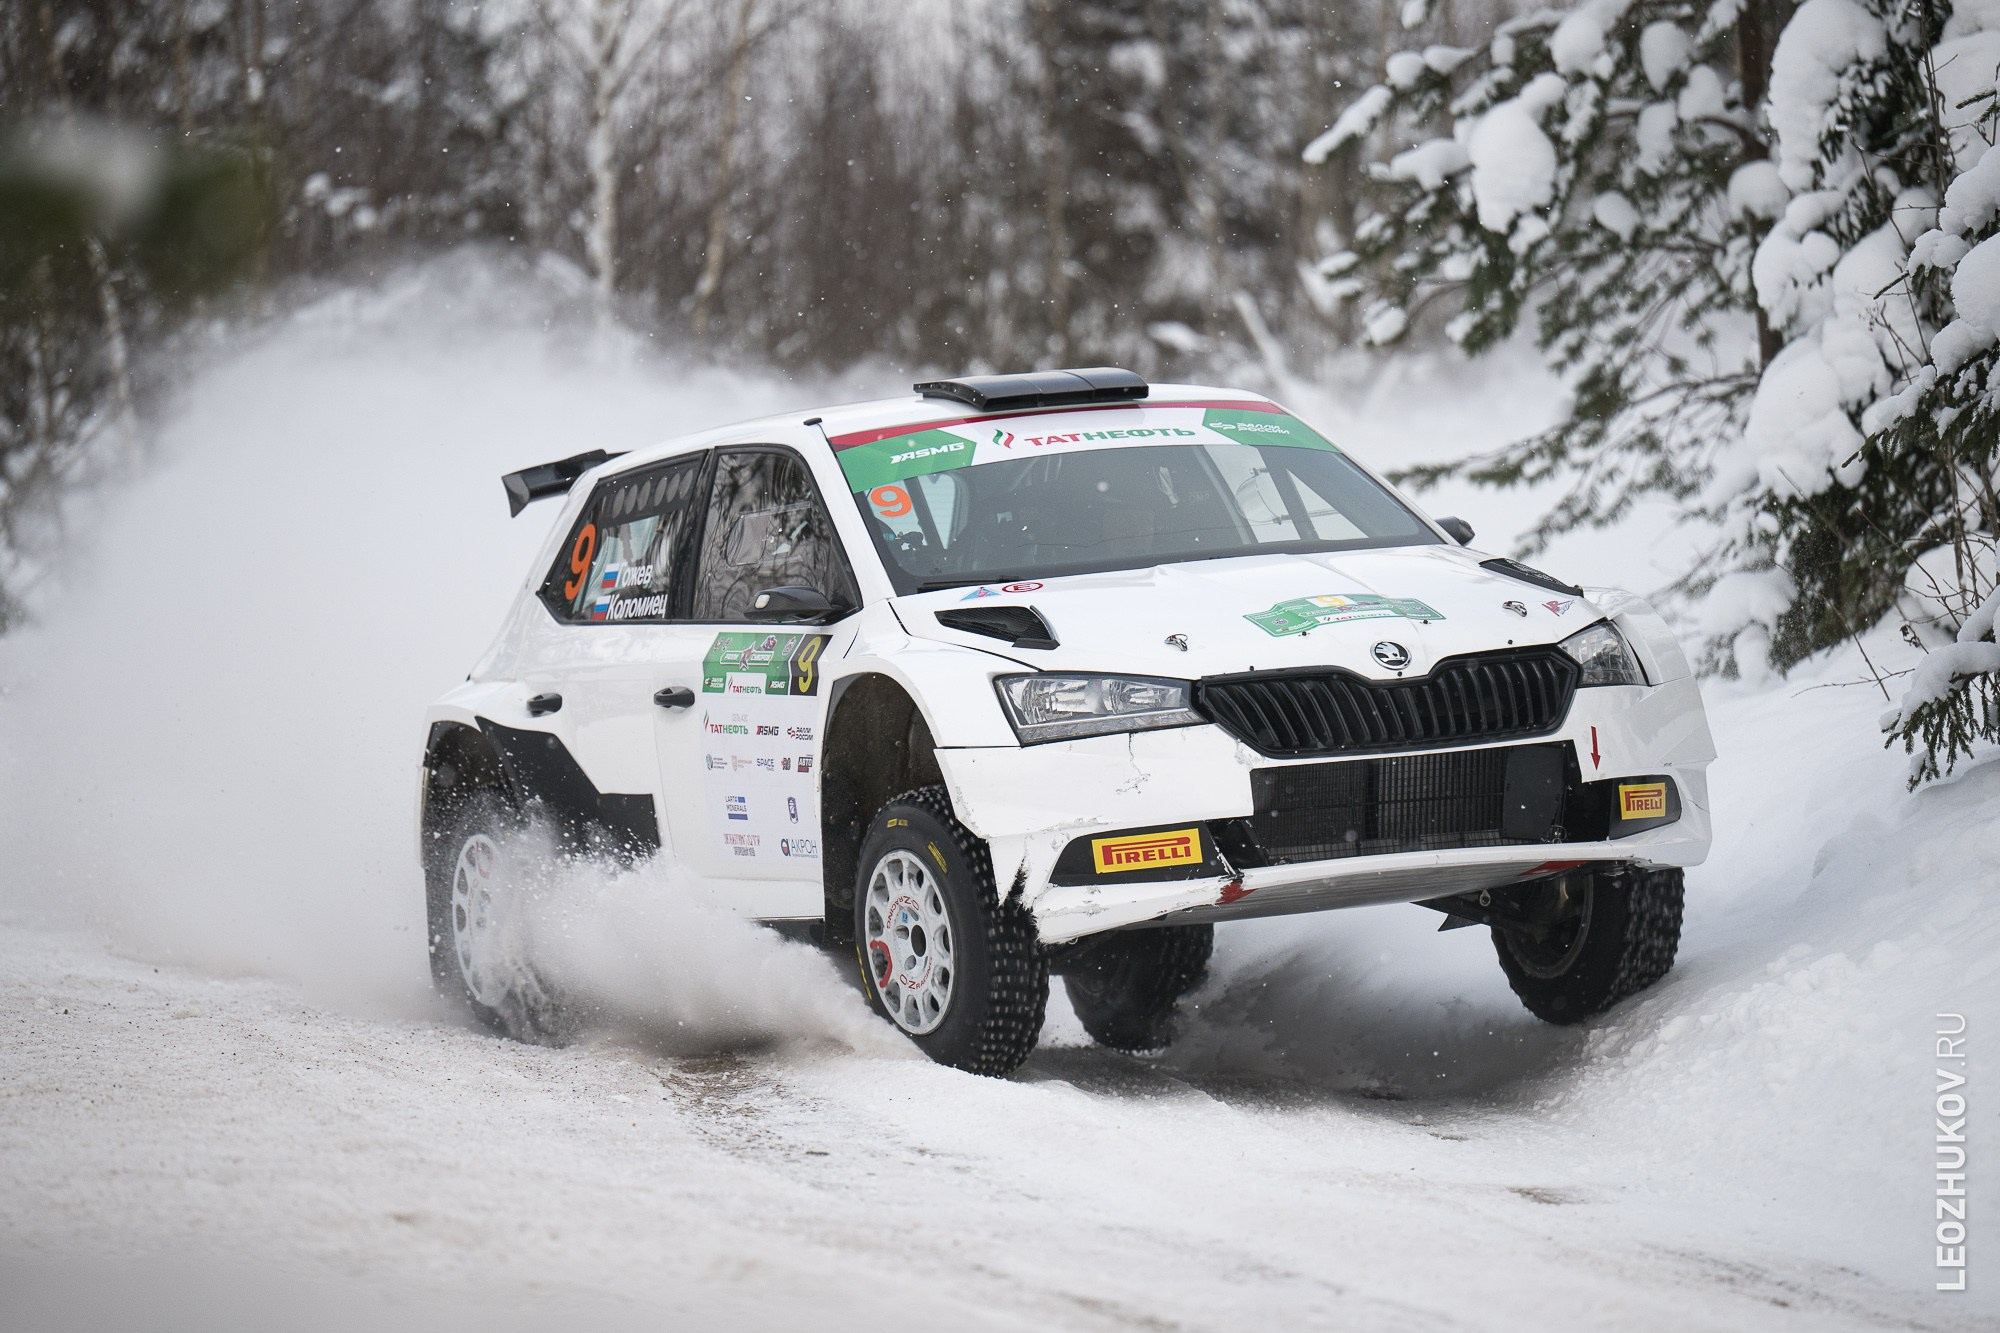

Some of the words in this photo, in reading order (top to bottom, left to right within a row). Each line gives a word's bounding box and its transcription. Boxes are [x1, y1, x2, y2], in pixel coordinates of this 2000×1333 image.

[1024, 428, 1196, 447] ТАТНЕФТЬ
[893, 442, 965, 465] ASMG
[870, 485, 912, 517] 9
[564, 523, 596, 600] 9
[606, 594, 668, 620] Коломиец
[1314, 595, 1346, 607] 9
[797, 636, 822, 693] 9
[732, 685, 762, 694] ТАТНЕФТЬ
[710, 724, 749, 735] ТАТНЕФТЬ
[757, 725, 779, 736] ASMG
[756, 758, 775, 768] SPACE
[1624, 789, 1662, 811] PIRELLI
[791, 839, 817, 853] АКРОН
[1101, 836, 1191, 866] PIRELLI
